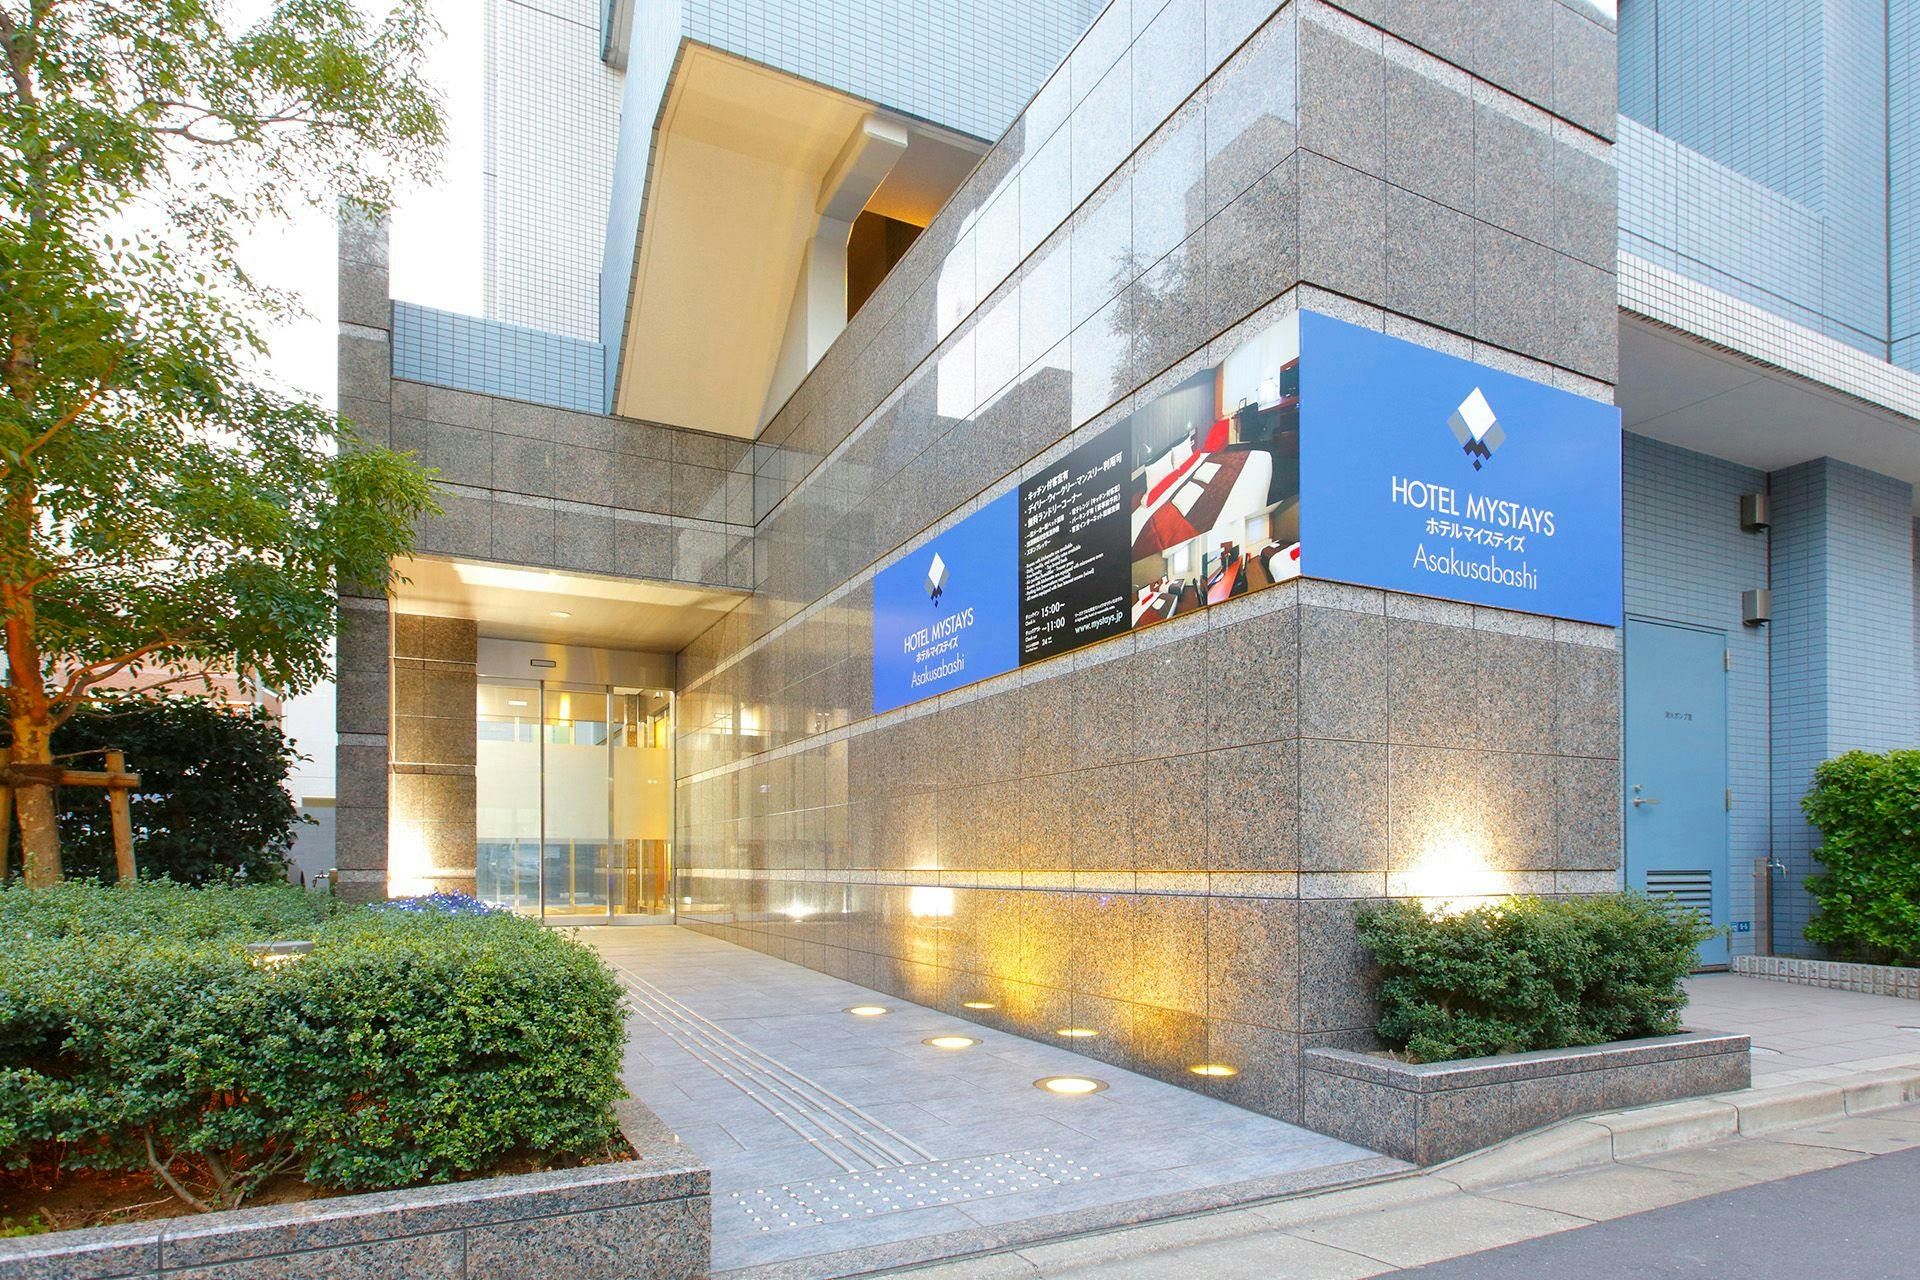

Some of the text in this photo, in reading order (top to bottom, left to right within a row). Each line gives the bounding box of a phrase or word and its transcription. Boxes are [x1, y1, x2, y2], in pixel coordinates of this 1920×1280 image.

[1392, 475, 1555, 537] HOTEL MYSTAYS
[1425, 517, 1526, 553] ホテルマイステイズ
[1413, 543, 1537, 590] Asakusabashi
[904, 607, 974, 654] HOTEL MYSTAYS
[915, 635, 959, 663] ホテルマイステイズ
[911, 652, 965, 688] Asakusabashi
